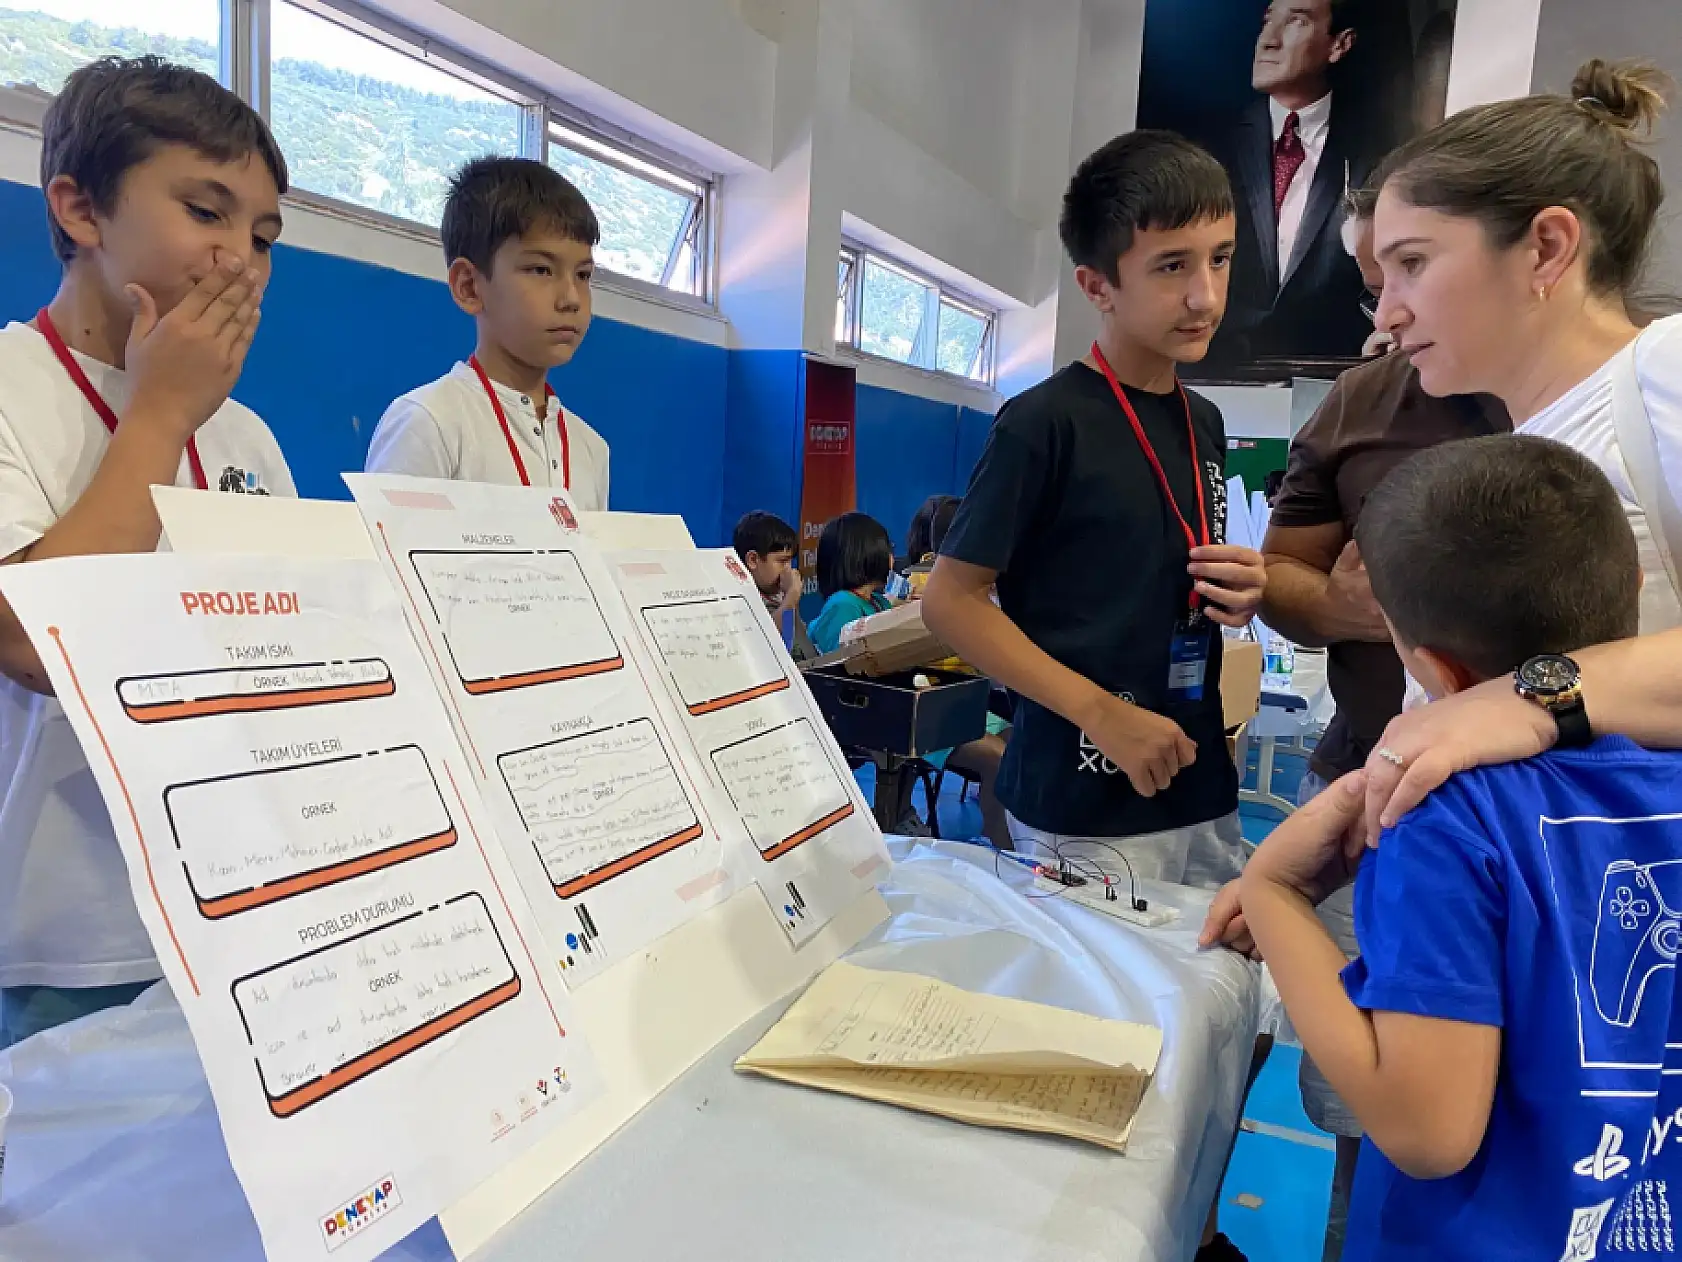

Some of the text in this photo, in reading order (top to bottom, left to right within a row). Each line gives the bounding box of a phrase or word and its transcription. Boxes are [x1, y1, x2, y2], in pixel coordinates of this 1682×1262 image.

[180, 591, 300, 615] PROJE ADI
[297, 892, 415, 944] PROBLEM DURUMU
[324, 1180, 393, 1236] DENEYAP
